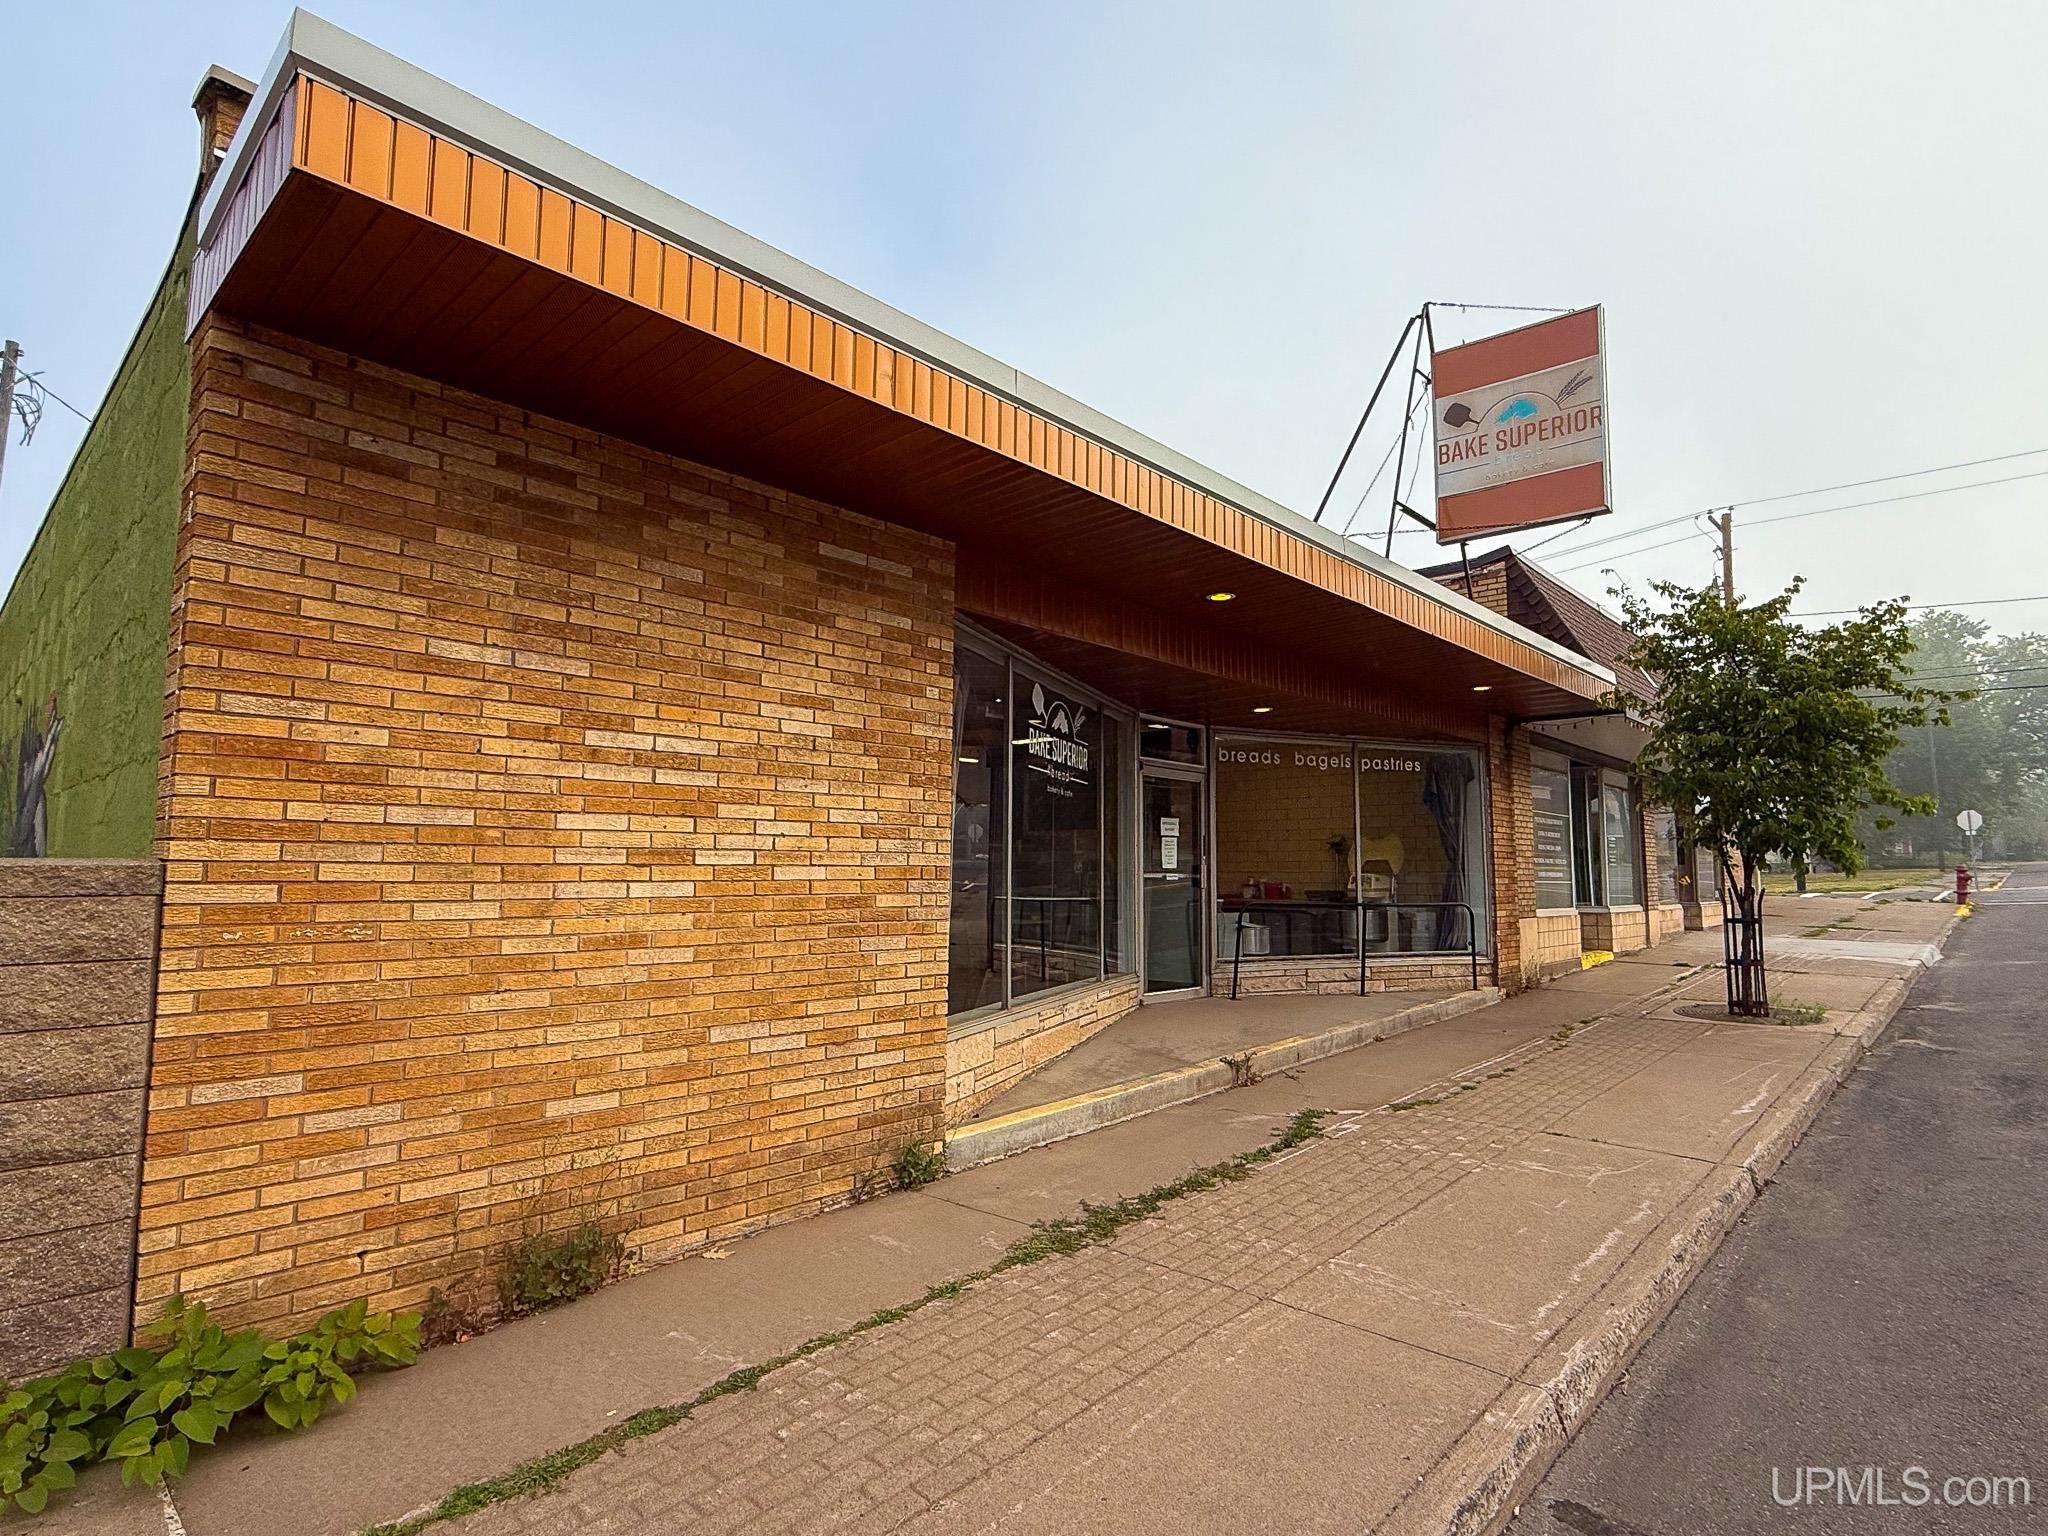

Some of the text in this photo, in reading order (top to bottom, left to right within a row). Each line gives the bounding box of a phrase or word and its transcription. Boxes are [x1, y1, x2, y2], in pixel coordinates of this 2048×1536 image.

[1439, 405, 1602, 465] BAKE SUPERIOR
[1029, 727, 1088, 771] BAKE SUPERIOR
[1218, 747, 1421, 772] breads bagels pastries
